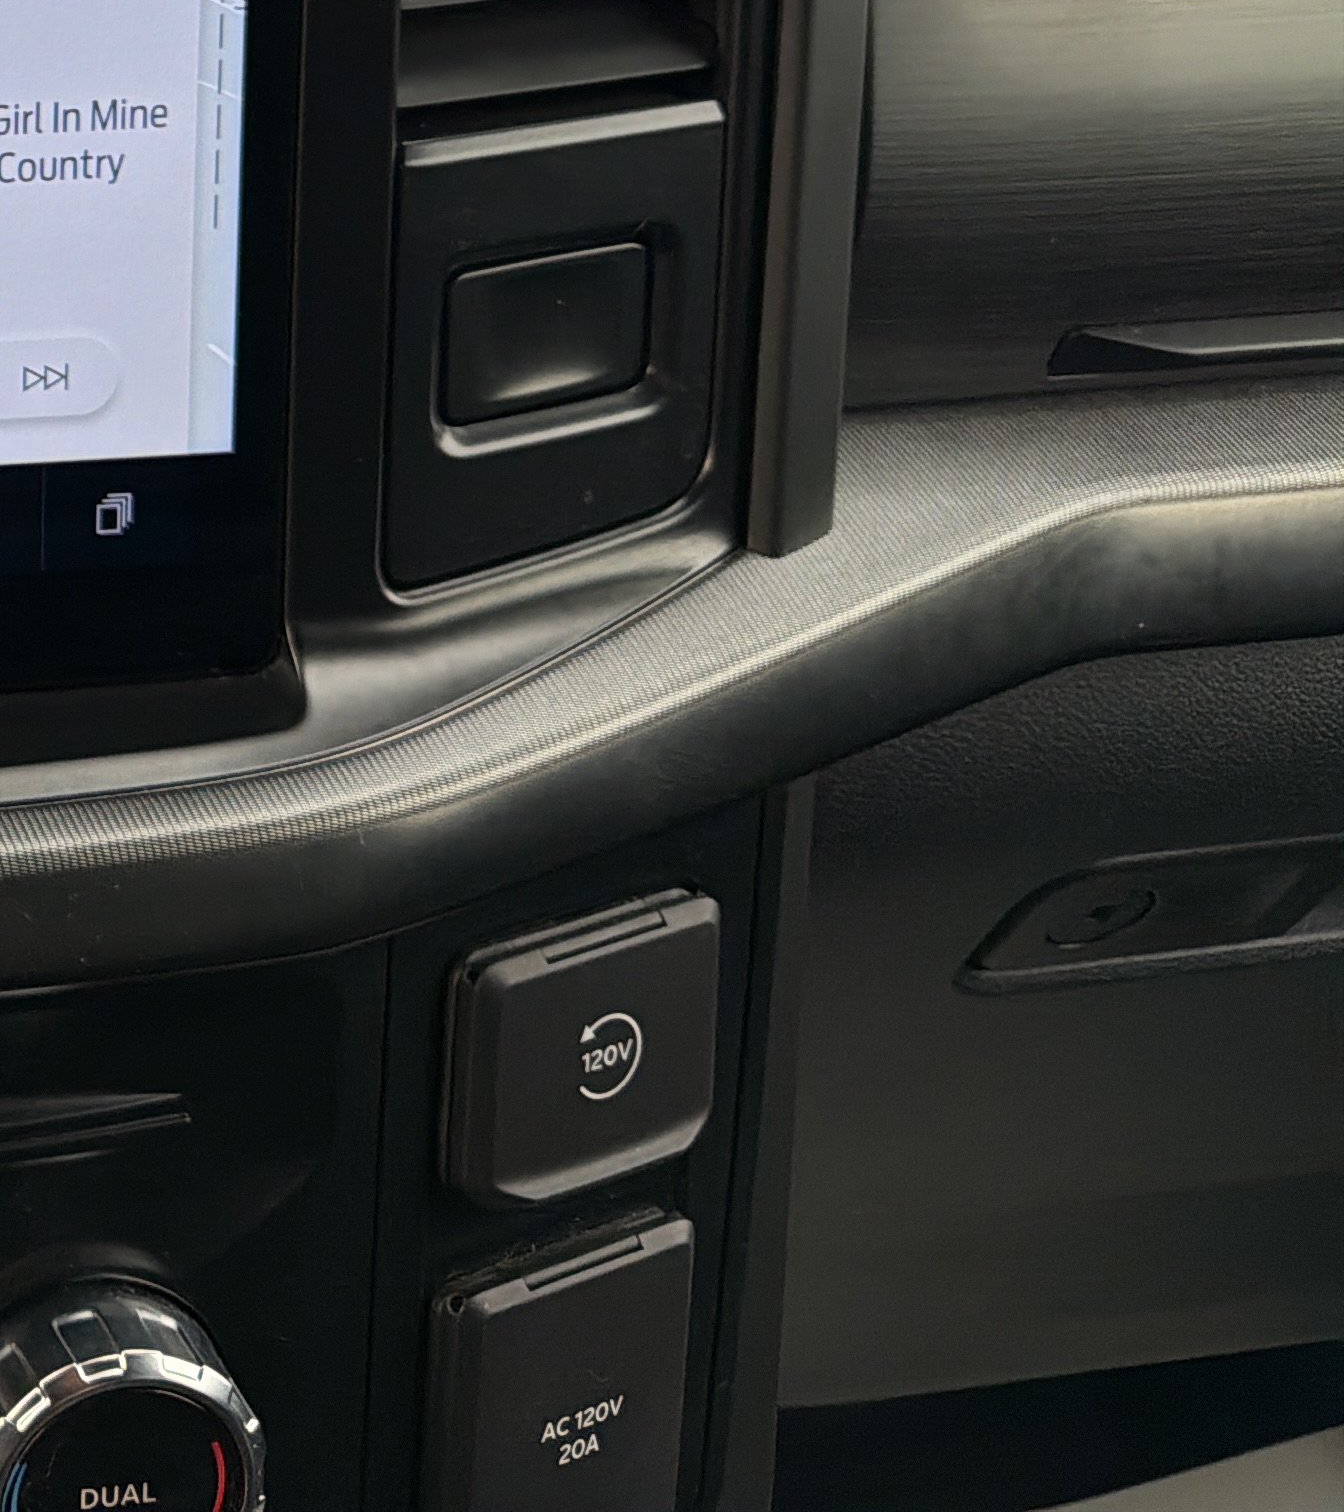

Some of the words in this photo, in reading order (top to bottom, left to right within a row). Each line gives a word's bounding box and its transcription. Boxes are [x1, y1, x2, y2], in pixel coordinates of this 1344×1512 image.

[53, 101, 81, 133] In
[90, 98, 168, 132] Mine
[581, 1038, 633, 1073] 120V
[540, 1415, 572, 1443] AC
[574, 1395, 624, 1430] 120V
[556, 1431, 599, 1465] 20A
[80, 1482, 157, 1510] DUAL
